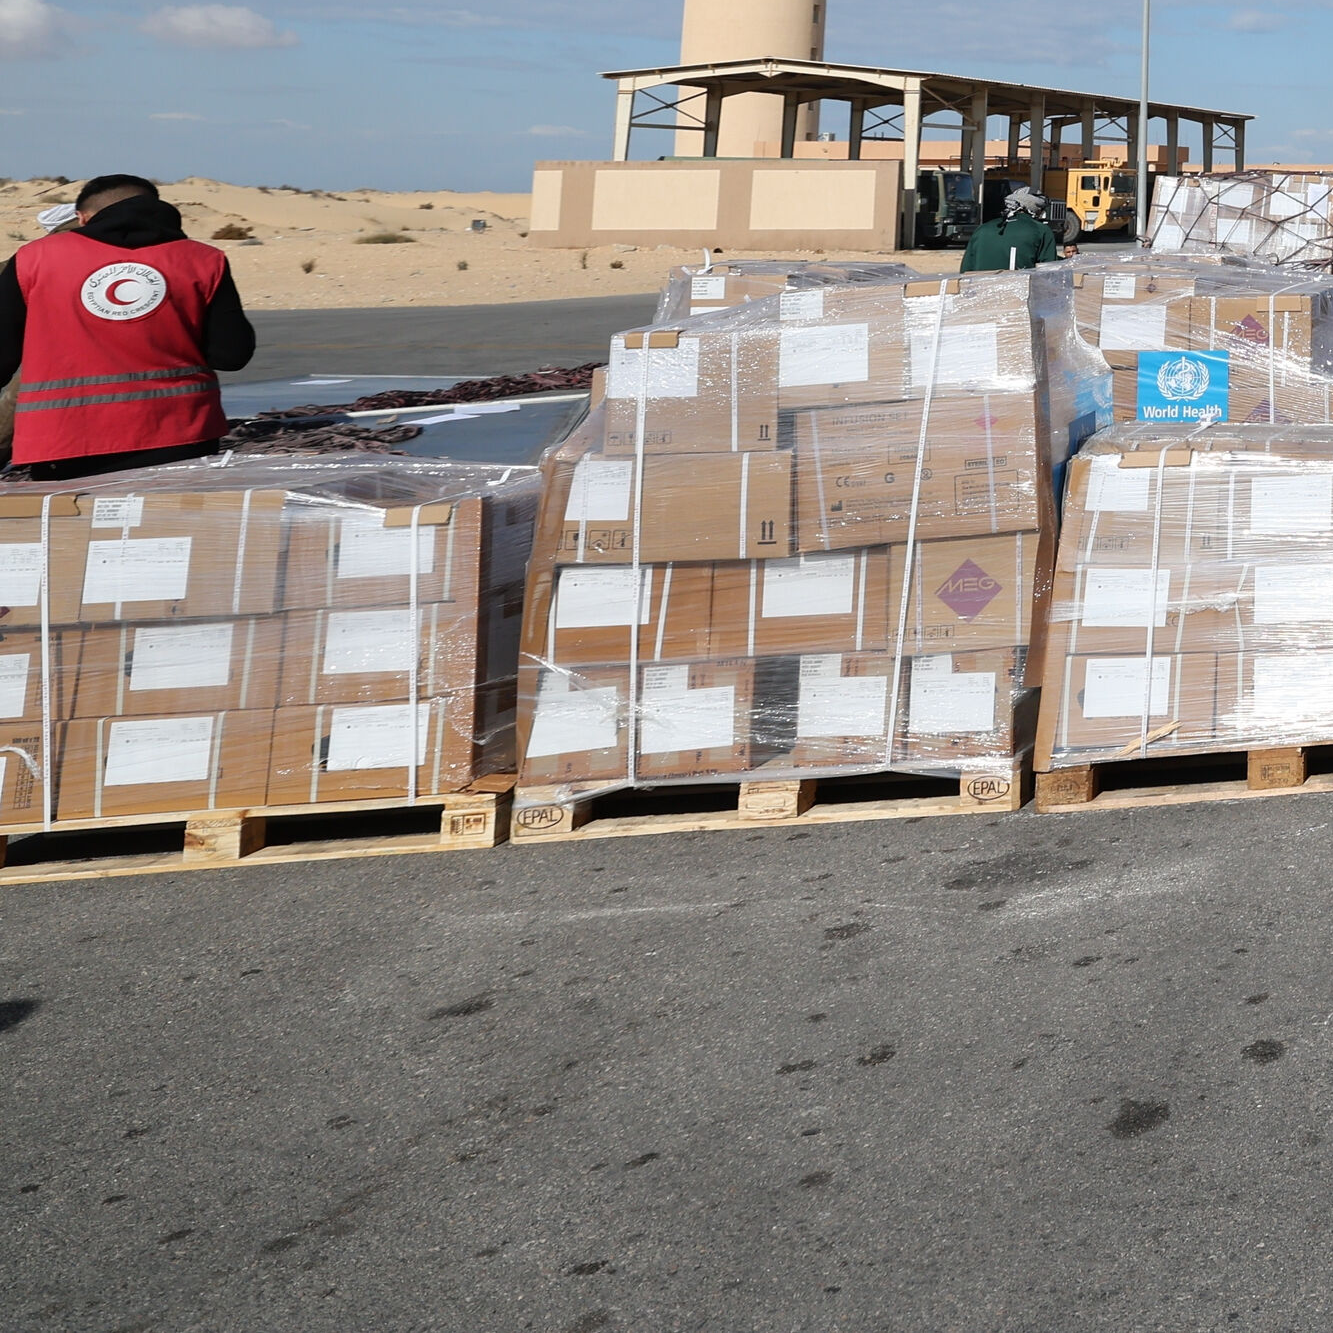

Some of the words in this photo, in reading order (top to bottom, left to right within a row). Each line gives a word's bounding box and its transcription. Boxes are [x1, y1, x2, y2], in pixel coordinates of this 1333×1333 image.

[87, 291, 110, 315] EGYPTIAN
[130, 290, 159, 314] CRESCENT
[1143, 406, 1177, 418] World
[1183, 405, 1222, 418] Health
[835, 476, 850, 488] CE
[884, 472, 895, 483] G
[935, 576, 996, 596] MEG
[973, 780, 1004, 796] EPAL
[523, 807, 558, 825] EPAL
